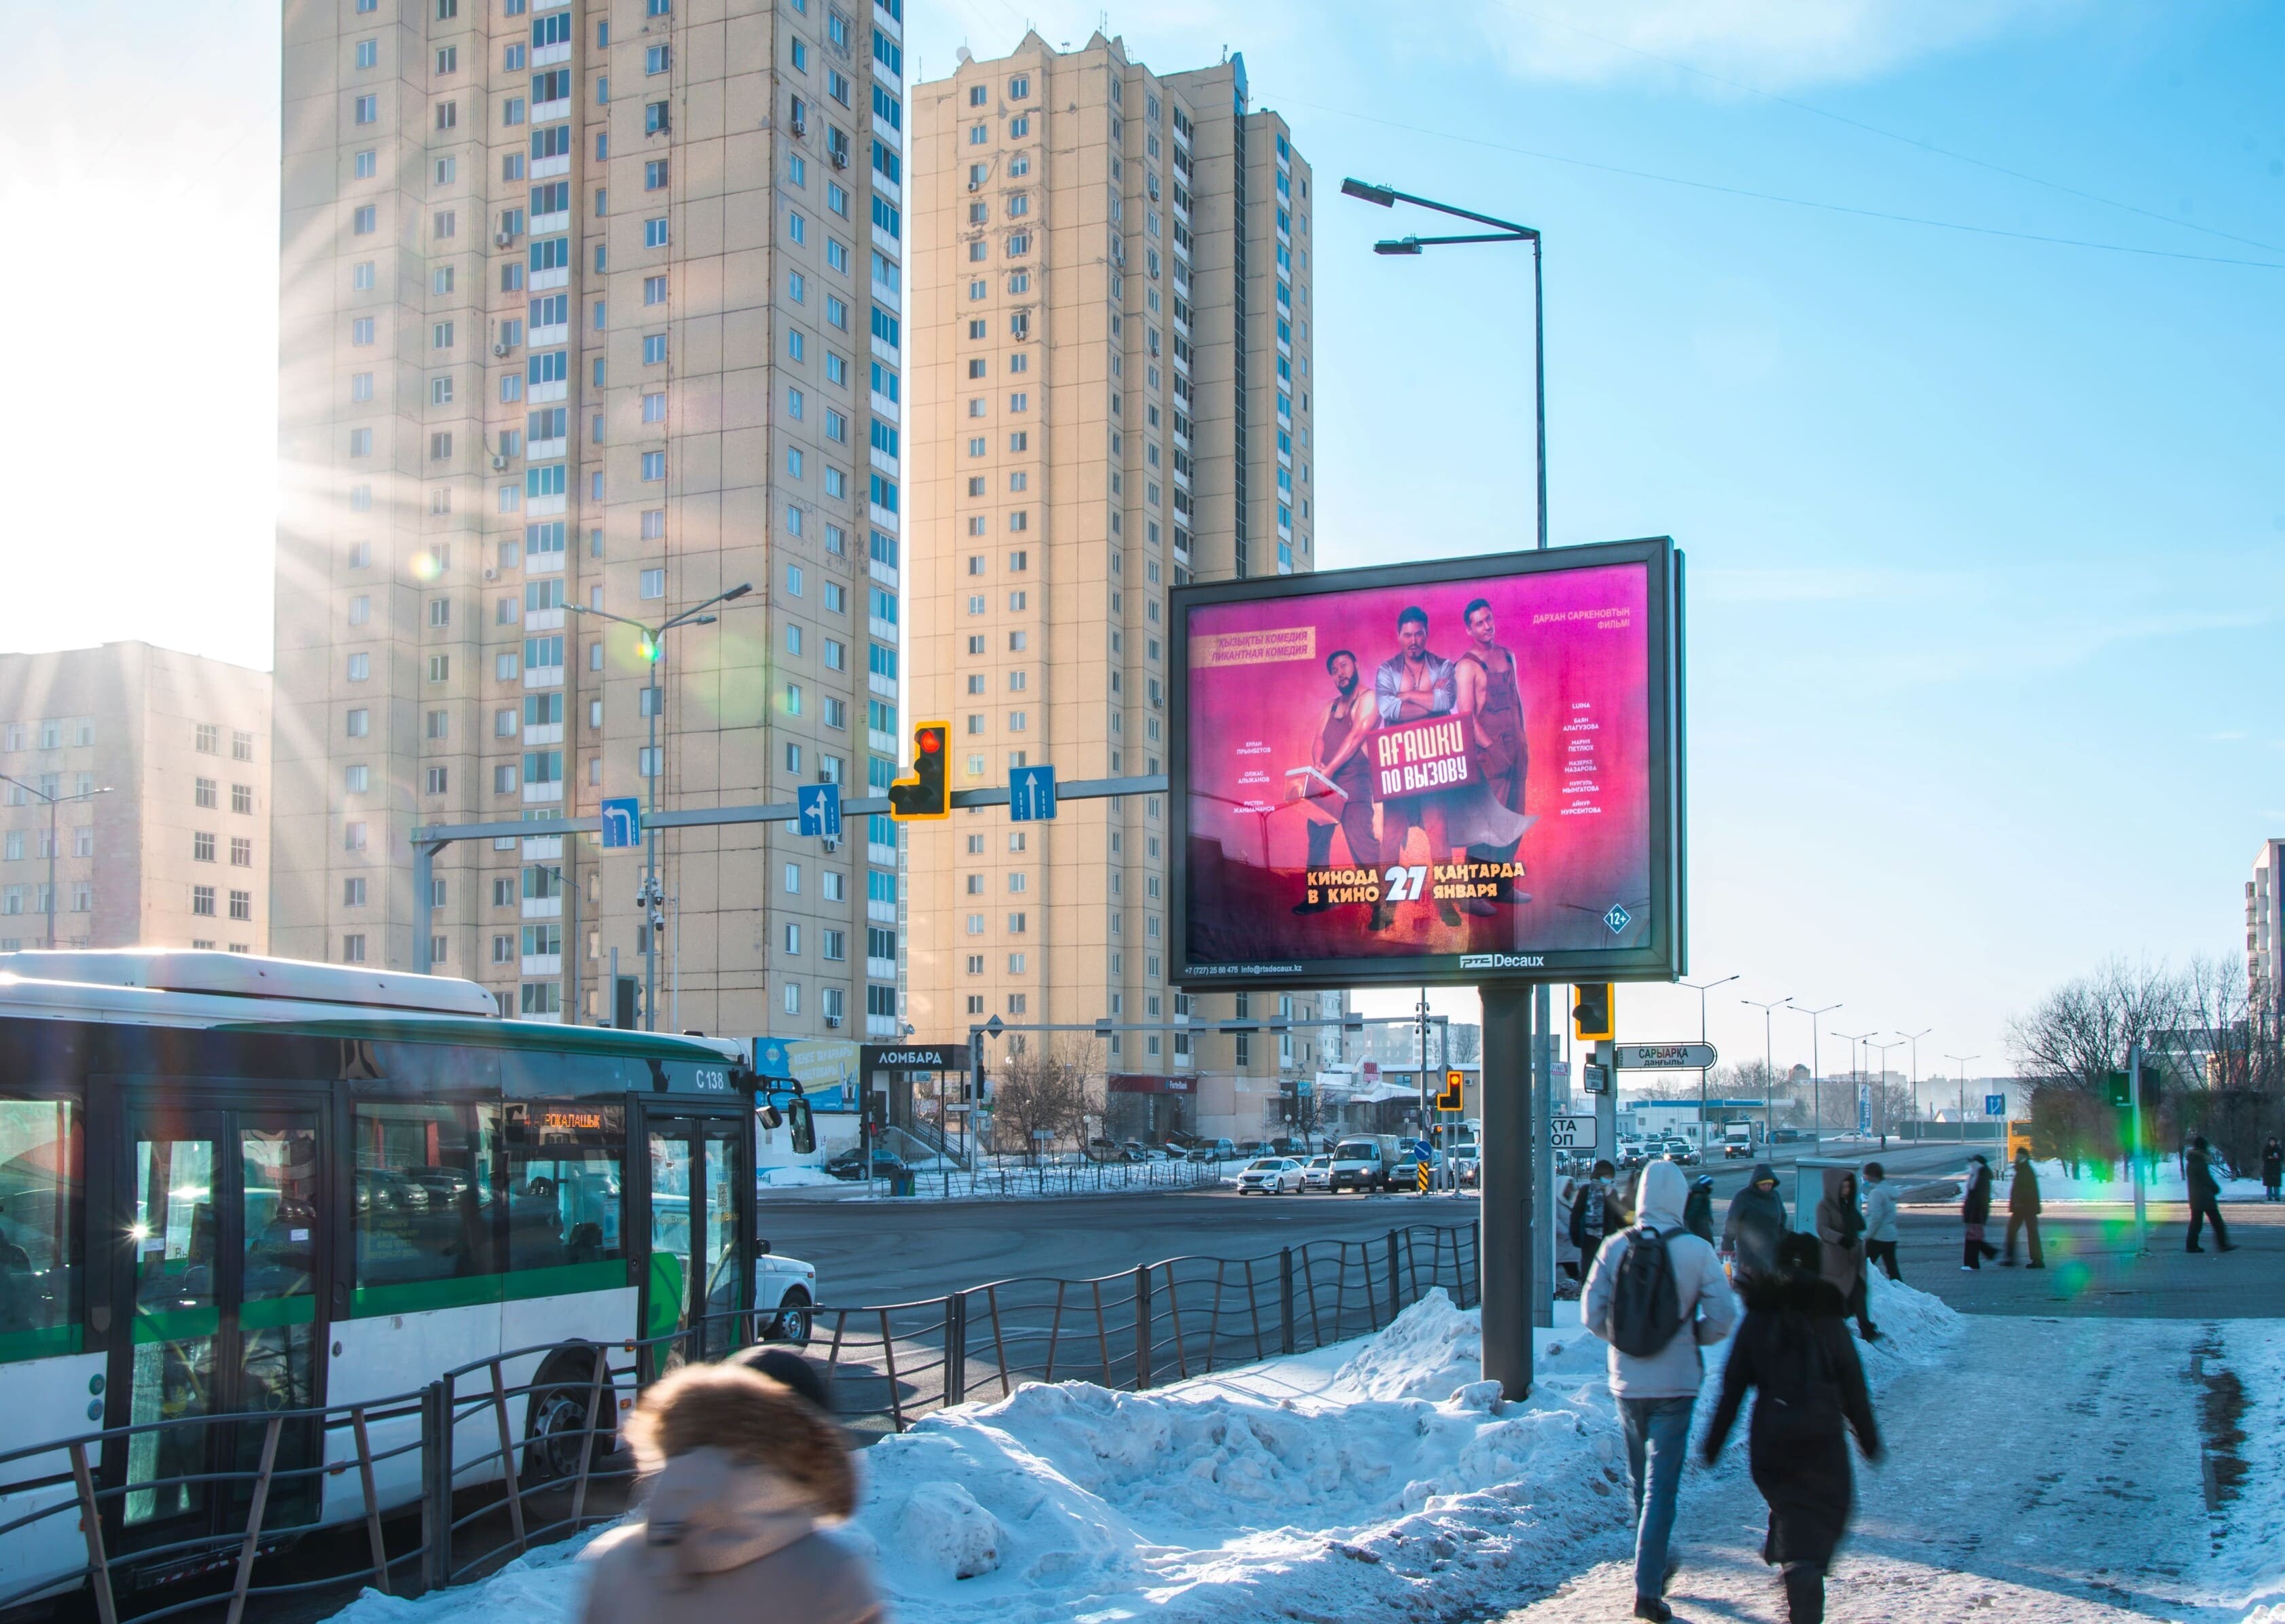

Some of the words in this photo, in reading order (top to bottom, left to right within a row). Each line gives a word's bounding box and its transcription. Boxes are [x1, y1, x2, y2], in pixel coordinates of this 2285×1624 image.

[1533, 613, 1566, 624] ДАРХАН
[1598, 619, 1630, 629] ФИЛЬМІ
[1266, 631, 1308, 643] КОМЕДИЯ
[1212, 649, 1263, 662] ПИКАНТНАЯ
[1266, 645, 1308, 657] КОМЕДИЯ
[1563, 723, 1599, 732] АЛАГУЗОВА
[1568, 744, 1594, 753] ПЕТЛЮХ
[1381, 768, 1401, 795] ПО
[1404, 755, 1467, 791] ВЫЗОВУ
[1564, 765, 1597, 773] НАЗАРОВА
[1307, 869, 1379, 886] КИНОДА
[1384, 866, 1427, 901] 27
[1433, 862, 1526, 882] ҚАҢТАРДА
[1308, 890, 1318, 904] В
[1327, 886, 1380, 903] КИНО
[1433, 883, 1498, 899] ЯНВАРЯ
[1609, 912, 1626, 926] 12+
[1494, 954, 1544, 967] Decaux
[1193, 967, 1209, 975] (727)
[1241, 964, 1302, 974] info@rtsdecaux.kz
[879, 1051, 943, 1064] ЛОМБАРД
[1638, 1047, 1689, 1060] САРЫАРҚА
[706, 1071, 723, 1089] 138
